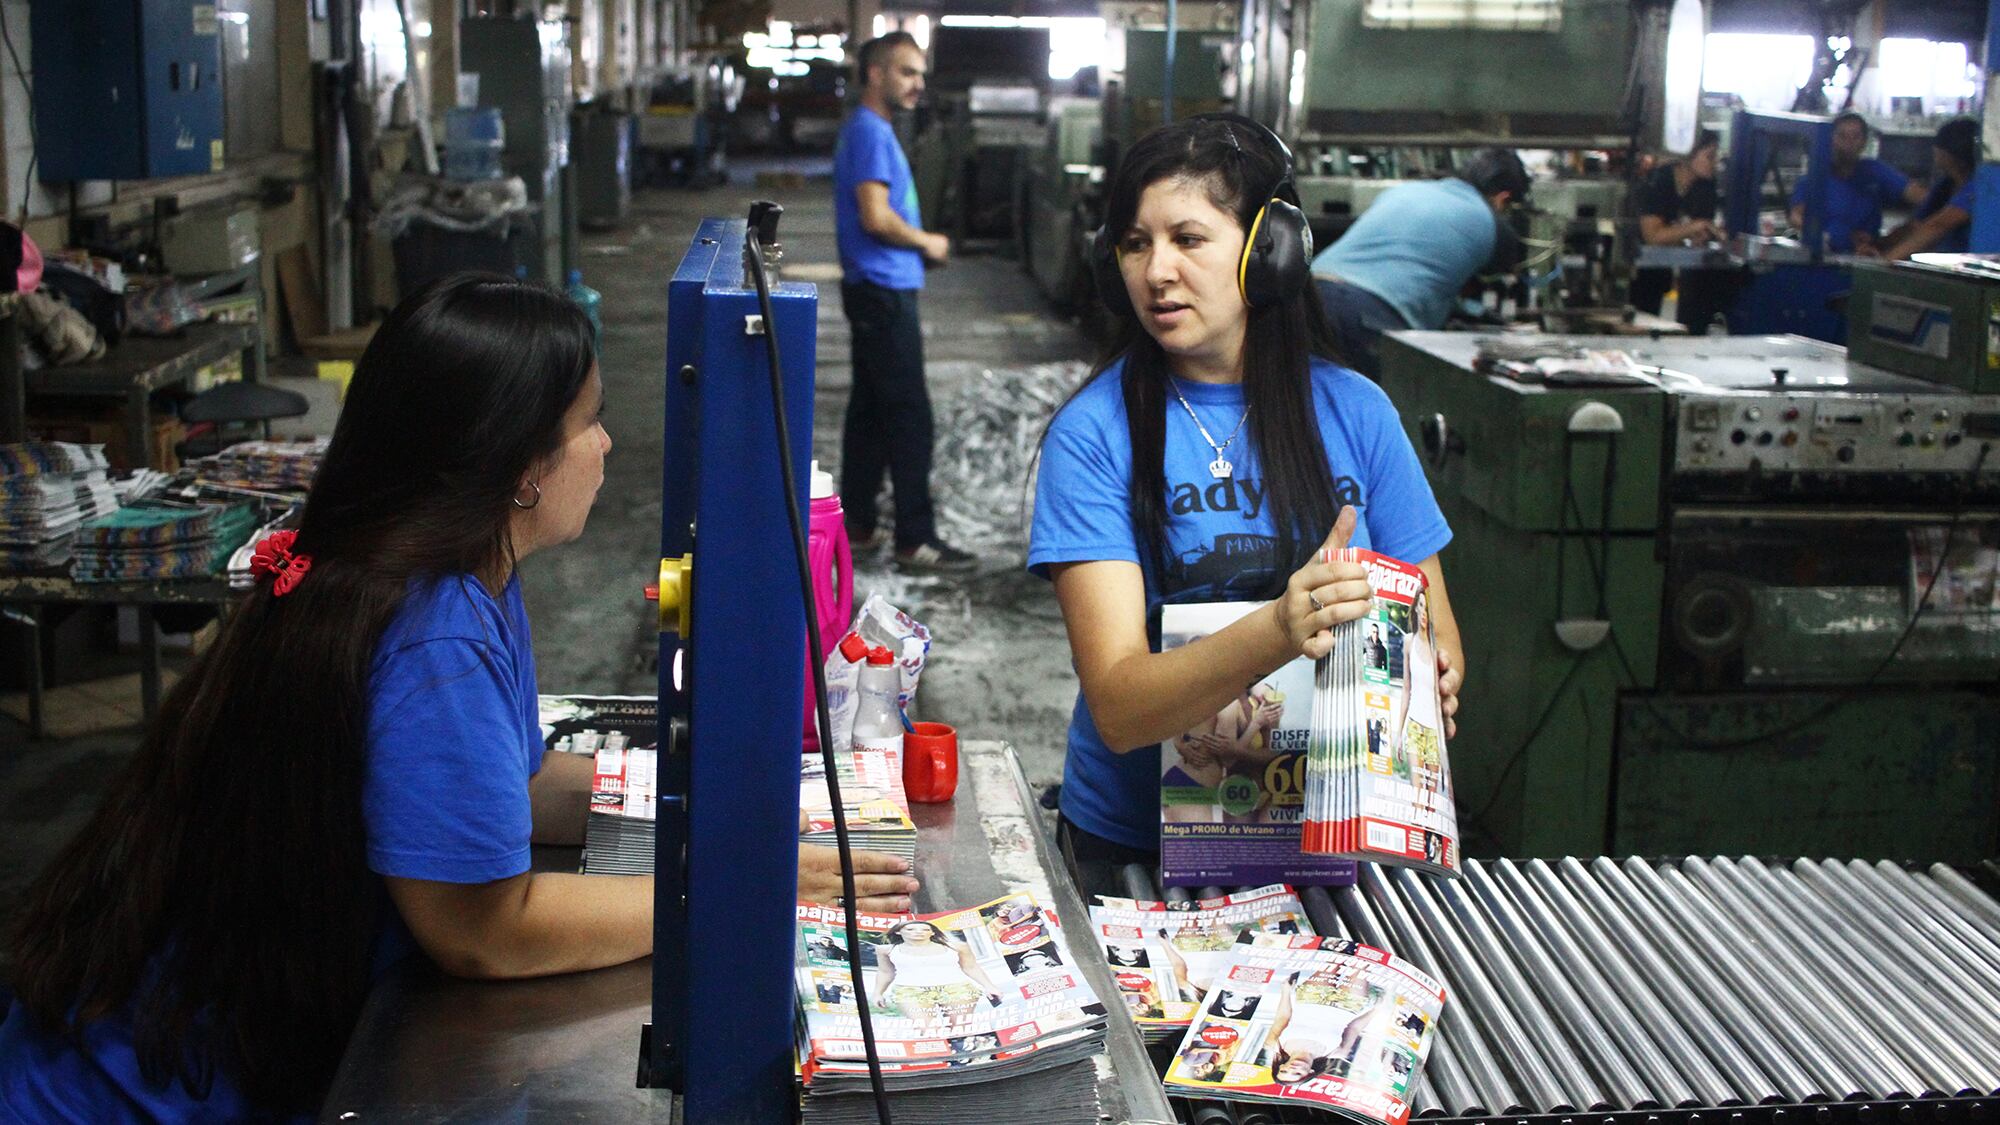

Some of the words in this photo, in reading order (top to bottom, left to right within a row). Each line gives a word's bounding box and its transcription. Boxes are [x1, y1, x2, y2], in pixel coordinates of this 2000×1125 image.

[1361, 560, 1422, 598] aparazzi
[1271, 741, 1282, 749] EL
[1226, 786, 1251, 802] 60
[1164, 825, 1190, 836] Mega
[1192, 825, 1227, 834] PROMO
[1229, 825, 1241, 834] de
[1242, 825, 1275, 834] Verano
[1252, 904, 1281, 918] UNA
[815, 1025, 896, 1039] MUETE
[1288, 1076, 1408, 1120] paparazzi
